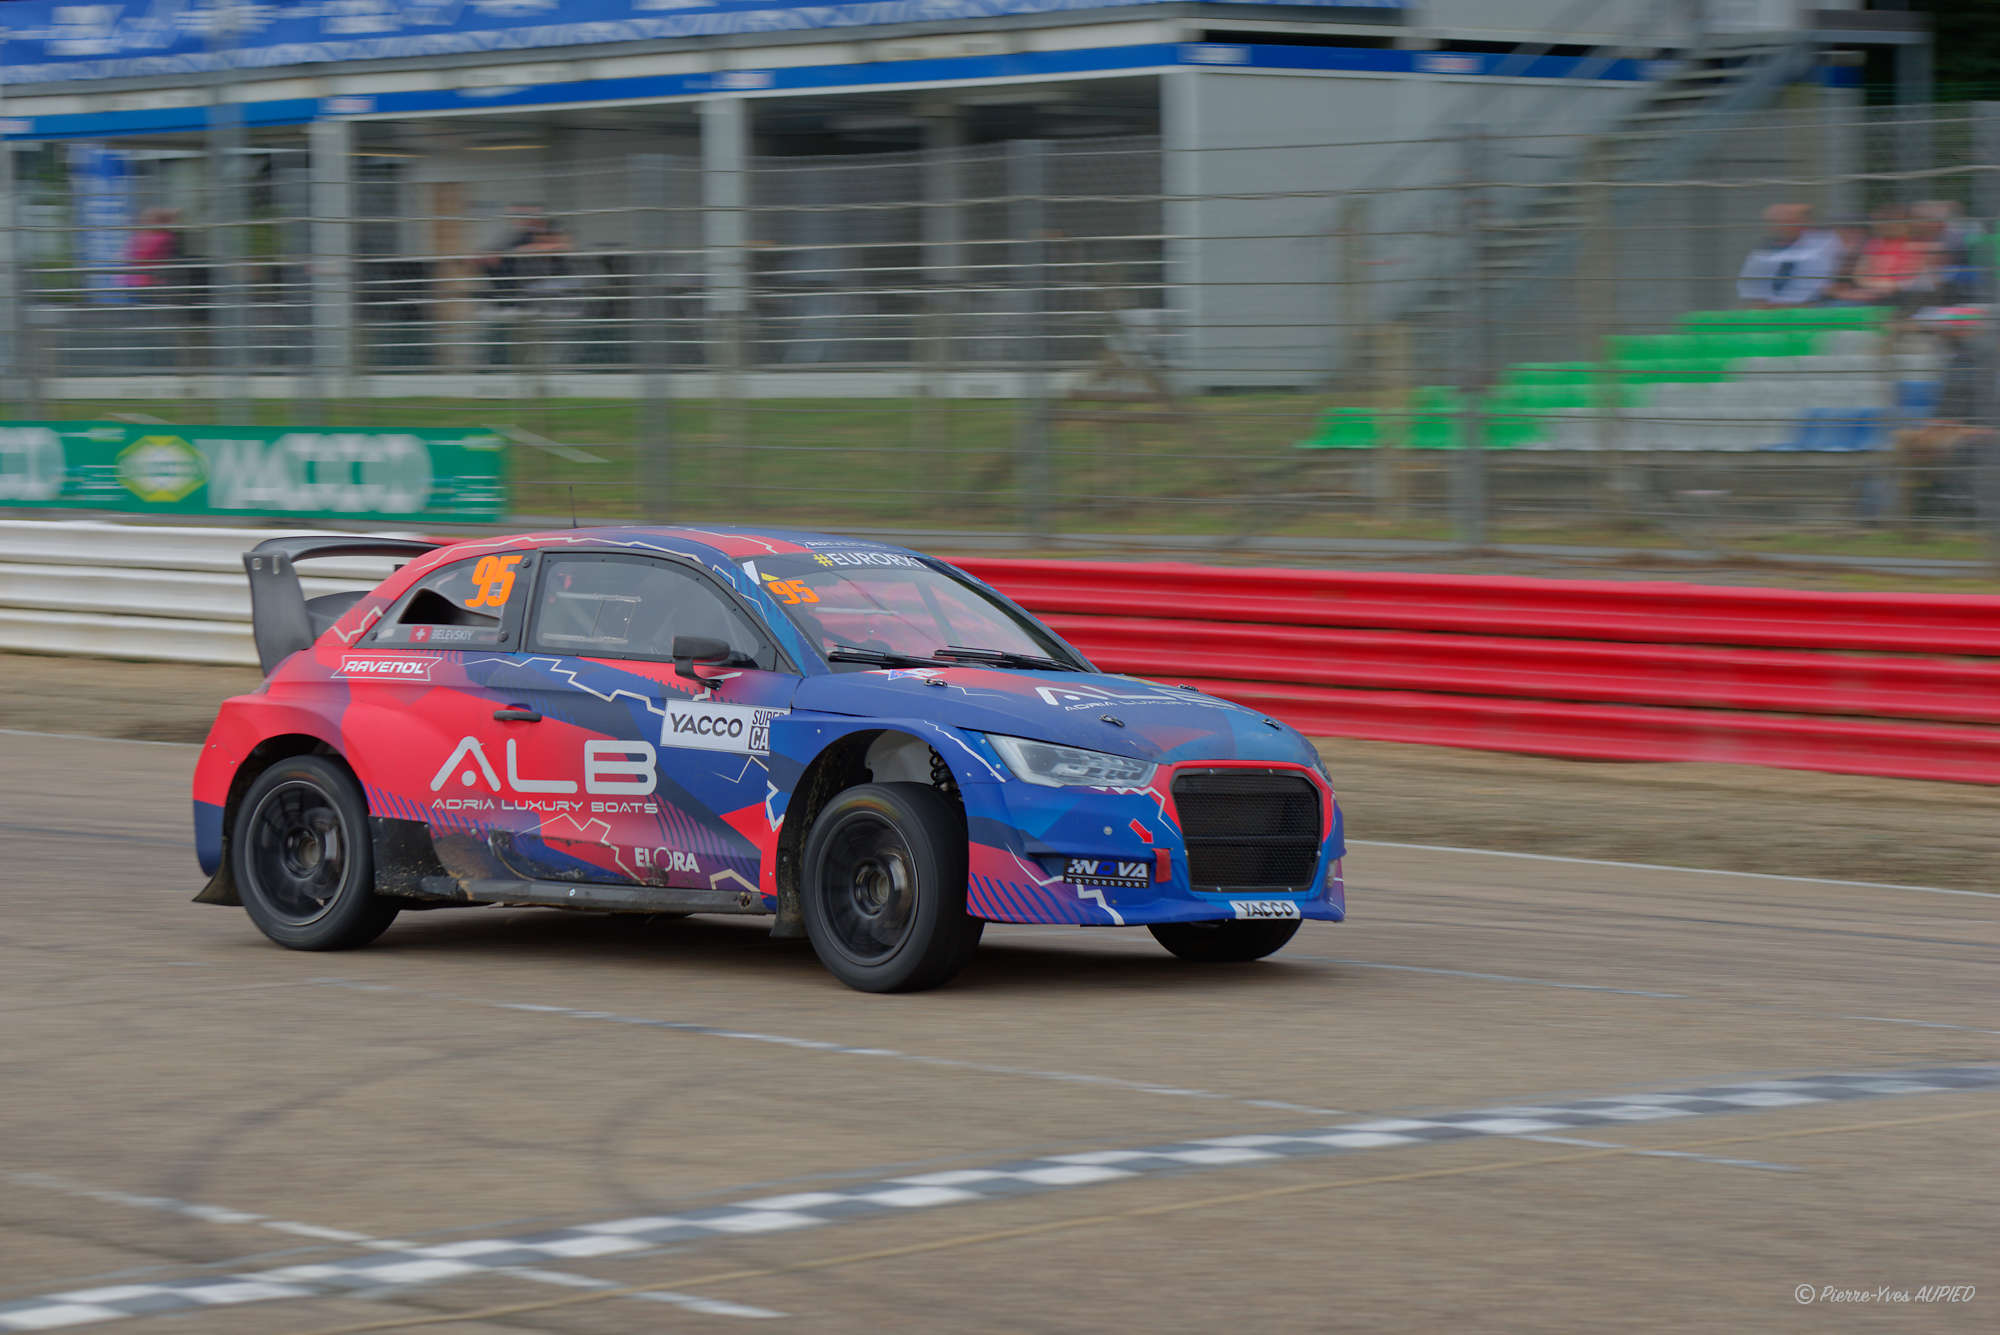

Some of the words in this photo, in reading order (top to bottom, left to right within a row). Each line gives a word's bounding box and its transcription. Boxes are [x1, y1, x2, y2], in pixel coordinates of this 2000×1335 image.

[465, 555, 524, 607] 95
[767, 579, 821, 605] 95
[343, 660, 426, 674] RAVENOL
[670, 712, 743, 738] YACCO
[430, 736, 658, 796] ALB
[431, 798, 495, 810] ADRIA
[501, 799, 584, 811] LUXURY
[591, 802, 658, 814] BOATS
[634, 846, 700, 873] ELORA
[1069, 858, 1148, 878] NOVA
[1065, 878, 1148, 888] MOTORSPORT
[1235, 902, 1294, 917] YACCO
